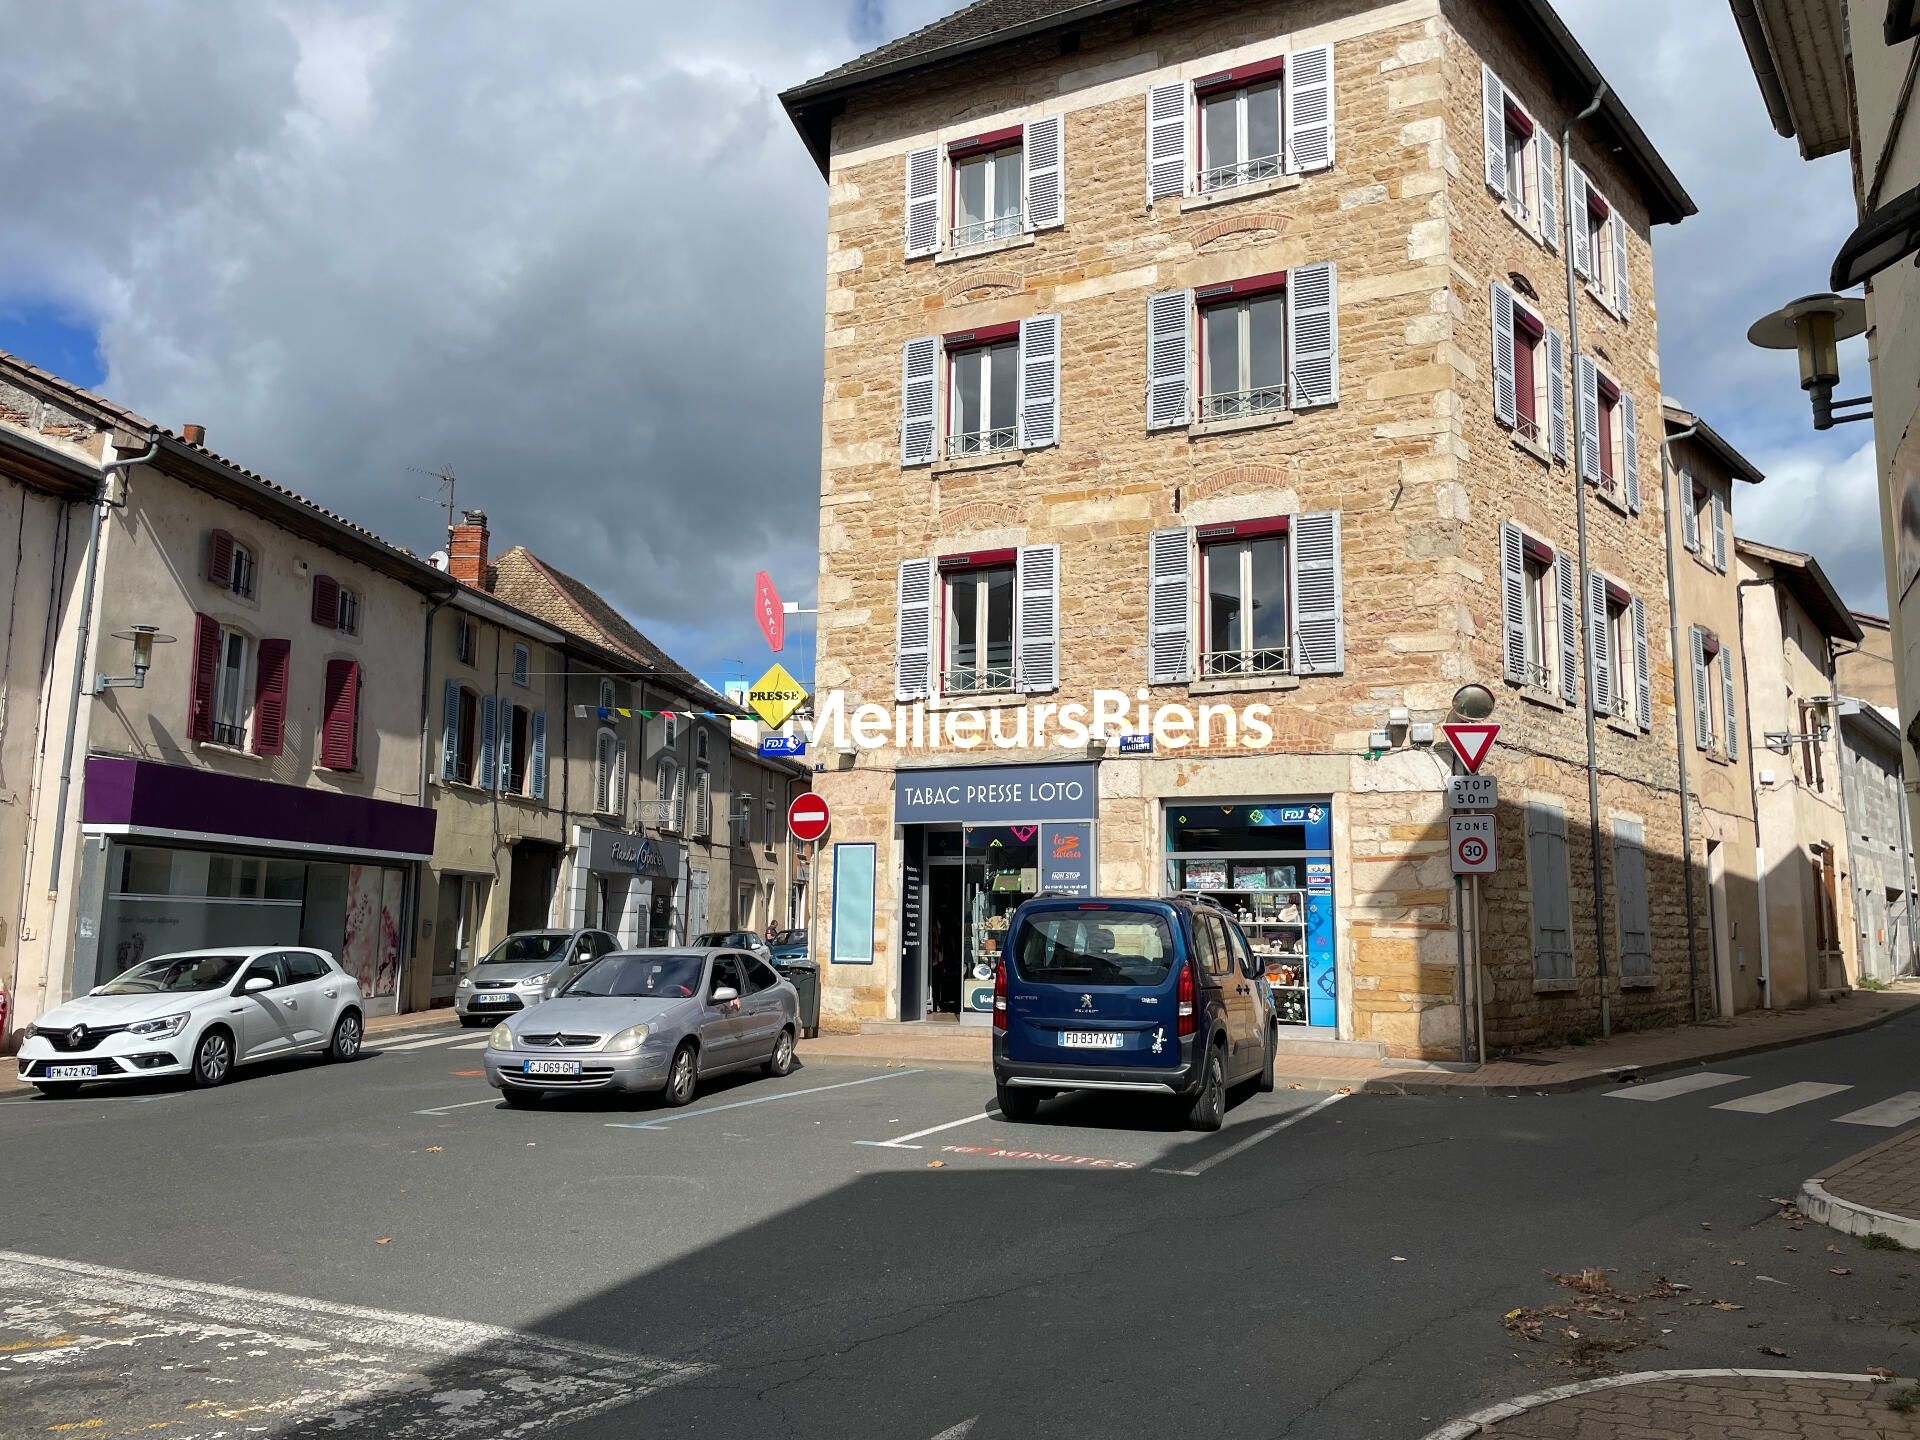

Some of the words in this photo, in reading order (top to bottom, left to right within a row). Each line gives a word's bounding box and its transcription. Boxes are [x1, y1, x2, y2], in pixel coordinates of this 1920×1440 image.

[761, 587, 777, 635] TABAC
[749, 691, 799, 701] PRESSE
[765, 738, 783, 748] FDJ
[1453, 780, 1492, 791] STOP
[905, 786, 960, 806] TABAC
[967, 783, 1022, 804] PRESSE
[1030, 781, 1083, 802] LOTO
[1284, 810, 1304, 820] FDJ
[1456, 822, 1489, 831] ZONE
[1464, 845, 1482, 857] 30
[1051, 871, 1065, 881] NON
[1065, 871, 1081, 880] STOP
[1066, 1033, 1114, 1045] FD-837-XY
[530, 1062, 574, 1073] CJ-069-GH
